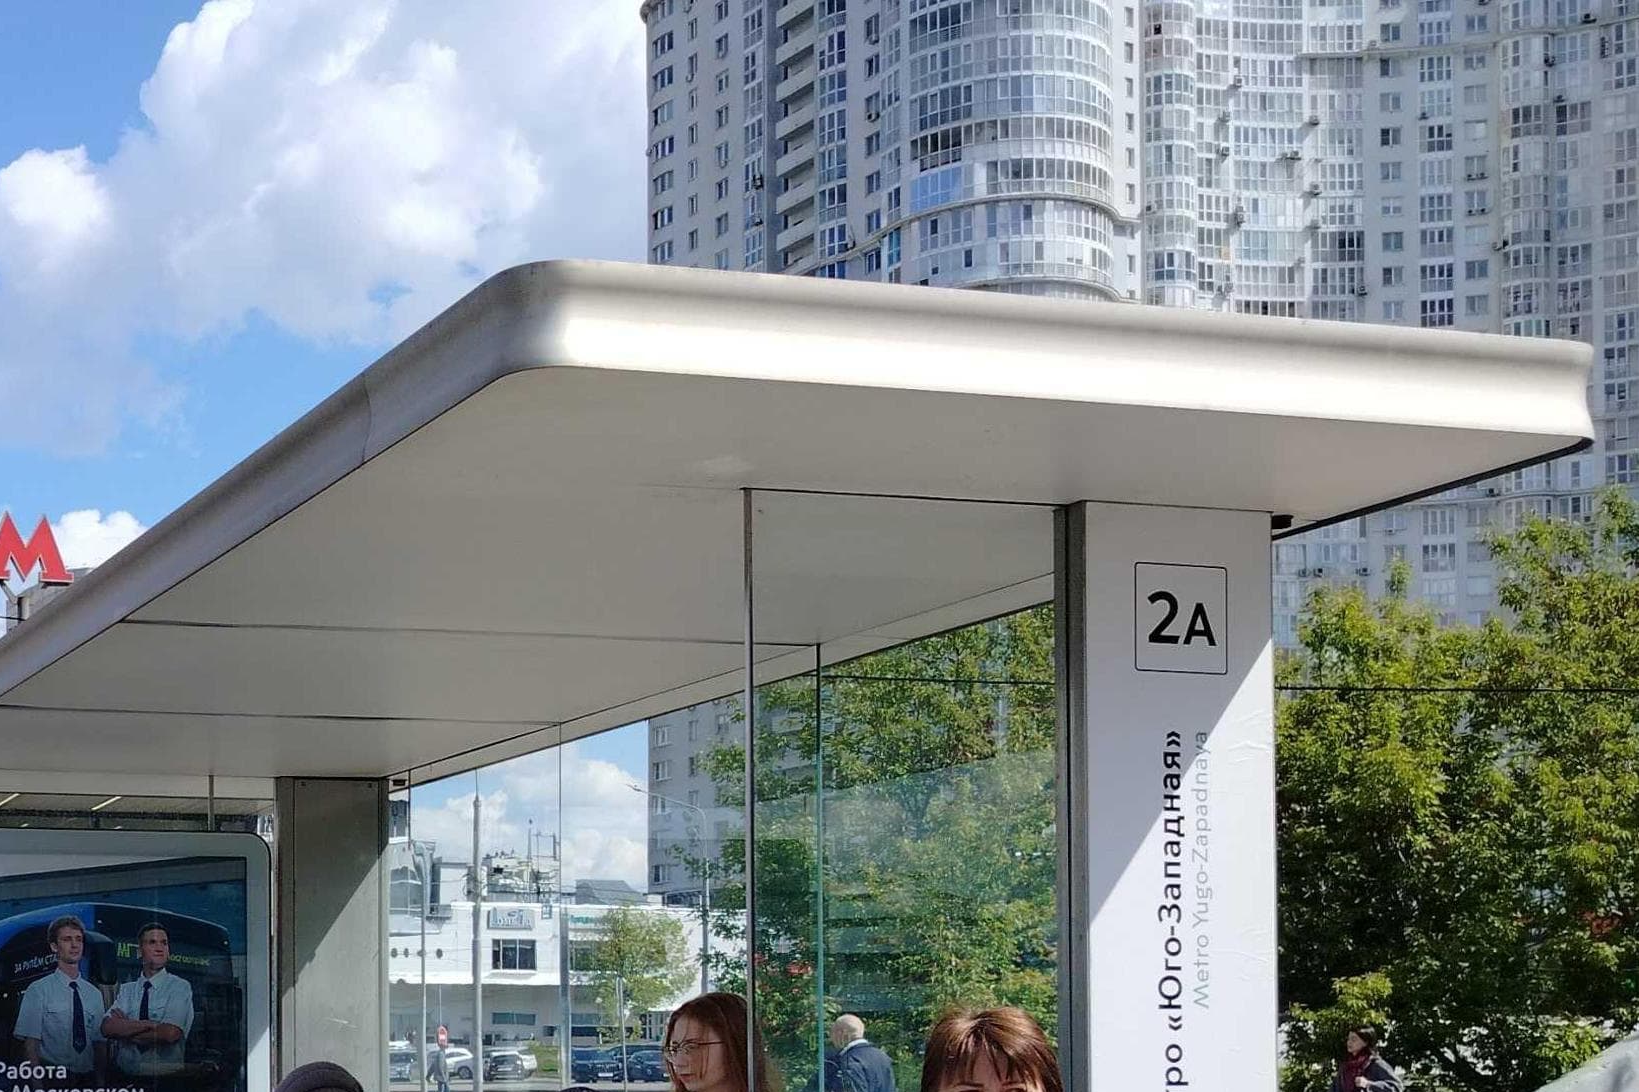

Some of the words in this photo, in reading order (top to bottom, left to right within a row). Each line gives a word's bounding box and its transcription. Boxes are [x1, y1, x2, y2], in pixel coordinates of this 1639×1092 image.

[1147, 590, 1217, 646] 2А
[1158, 730, 1185, 1031] «Юго-Западная»
[1191, 730, 1212, 929] Yugo-Zapadnaya
[1193, 934, 1210, 1009] Metro
